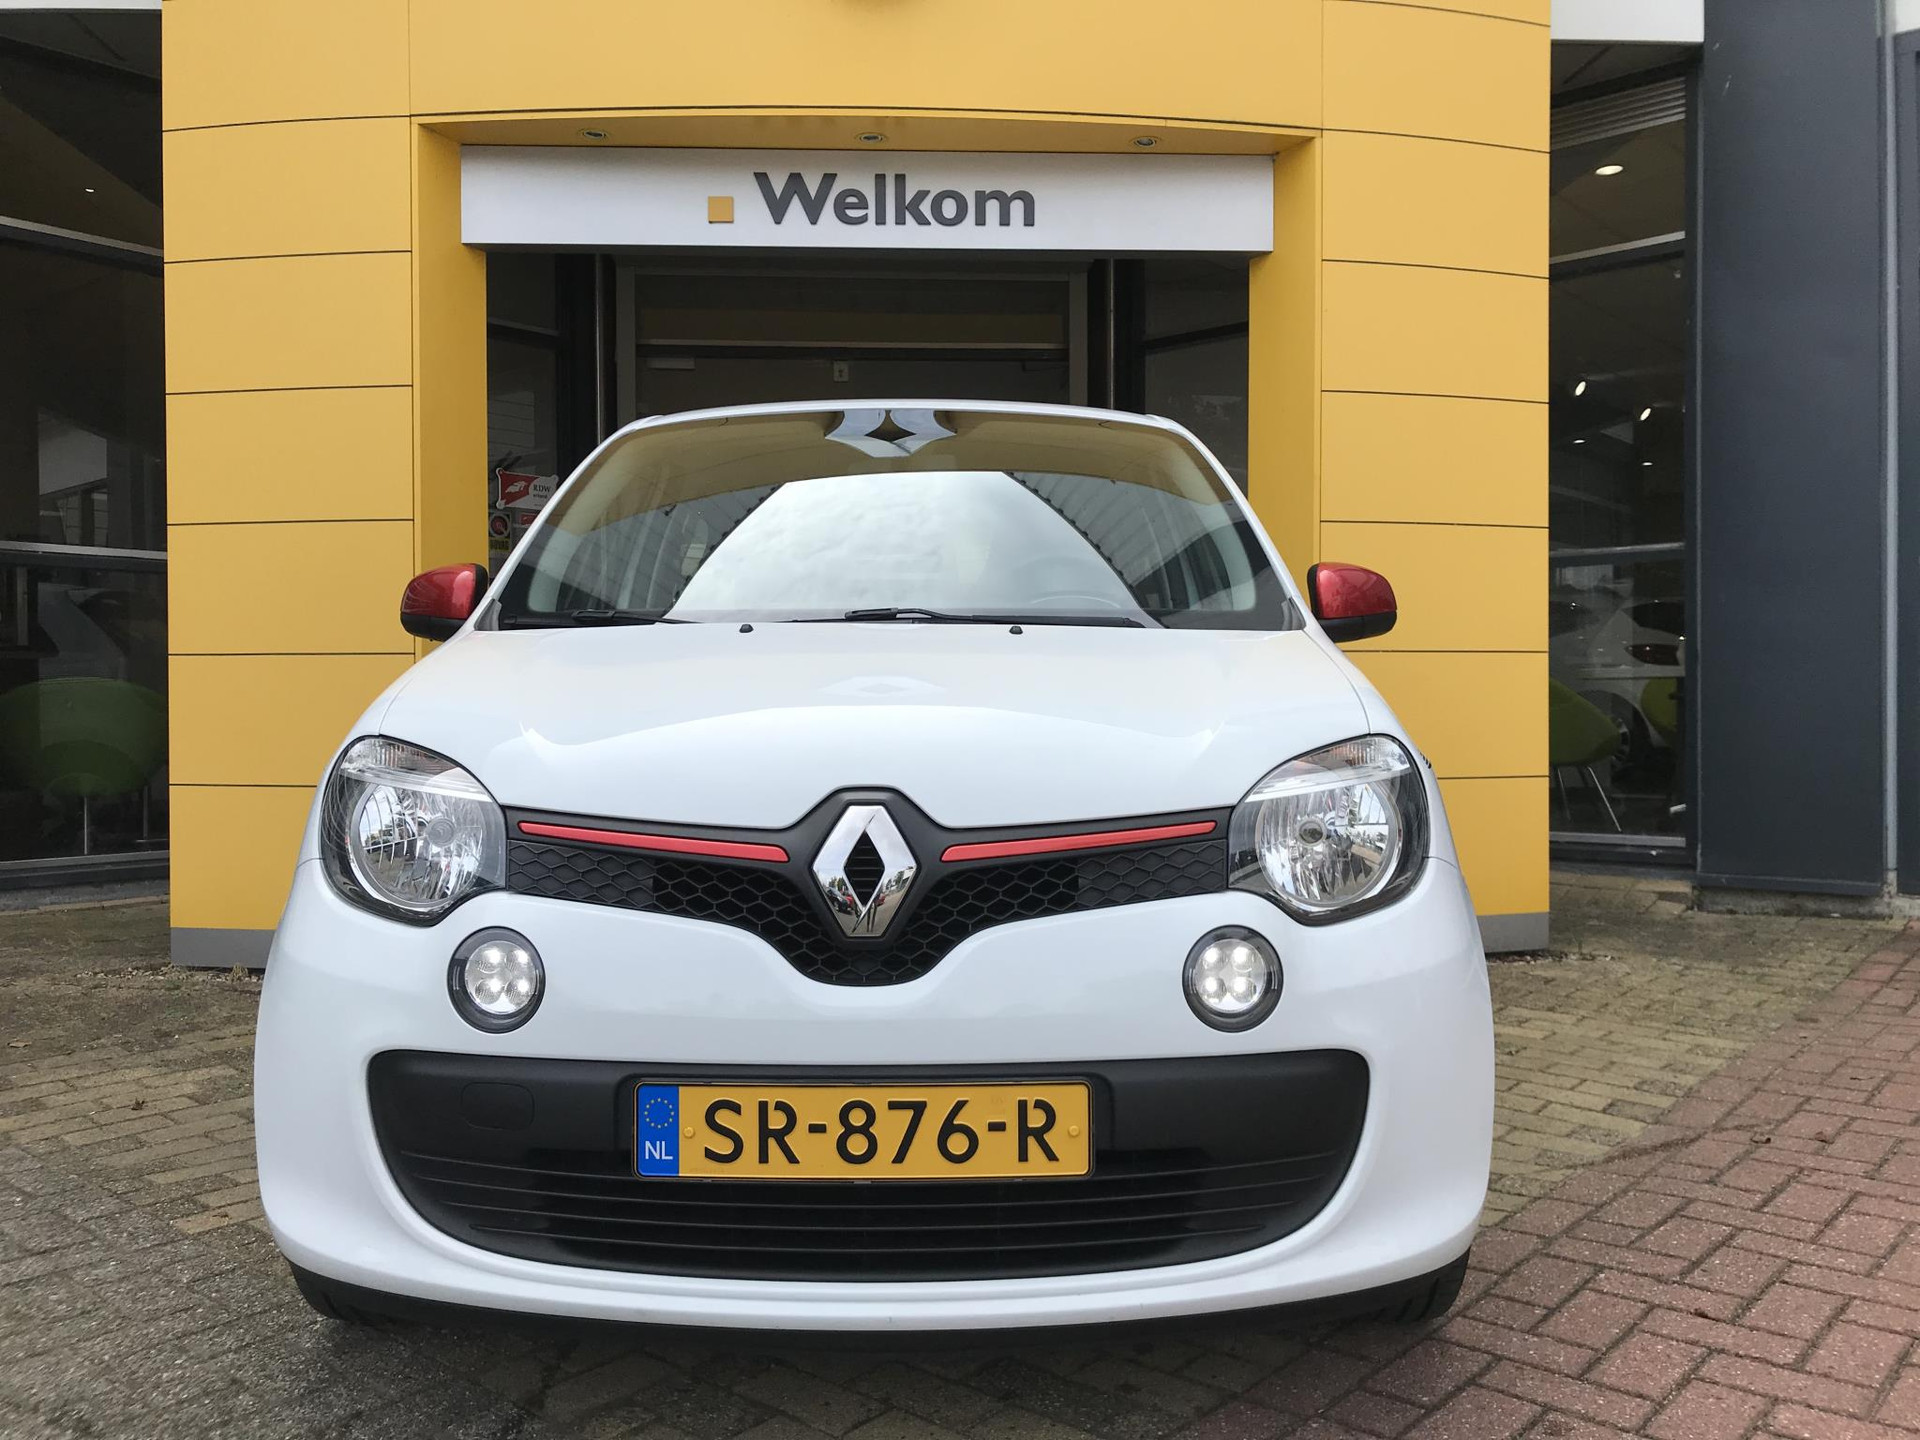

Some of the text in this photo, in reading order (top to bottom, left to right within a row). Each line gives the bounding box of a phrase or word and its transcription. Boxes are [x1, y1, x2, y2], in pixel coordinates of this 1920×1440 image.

[753, 172, 1035, 227] Welkom
[533, 484, 551, 493] RDW
[704, 1098, 1059, 1164] SR-876-R
[644, 1140, 673, 1161] NL
